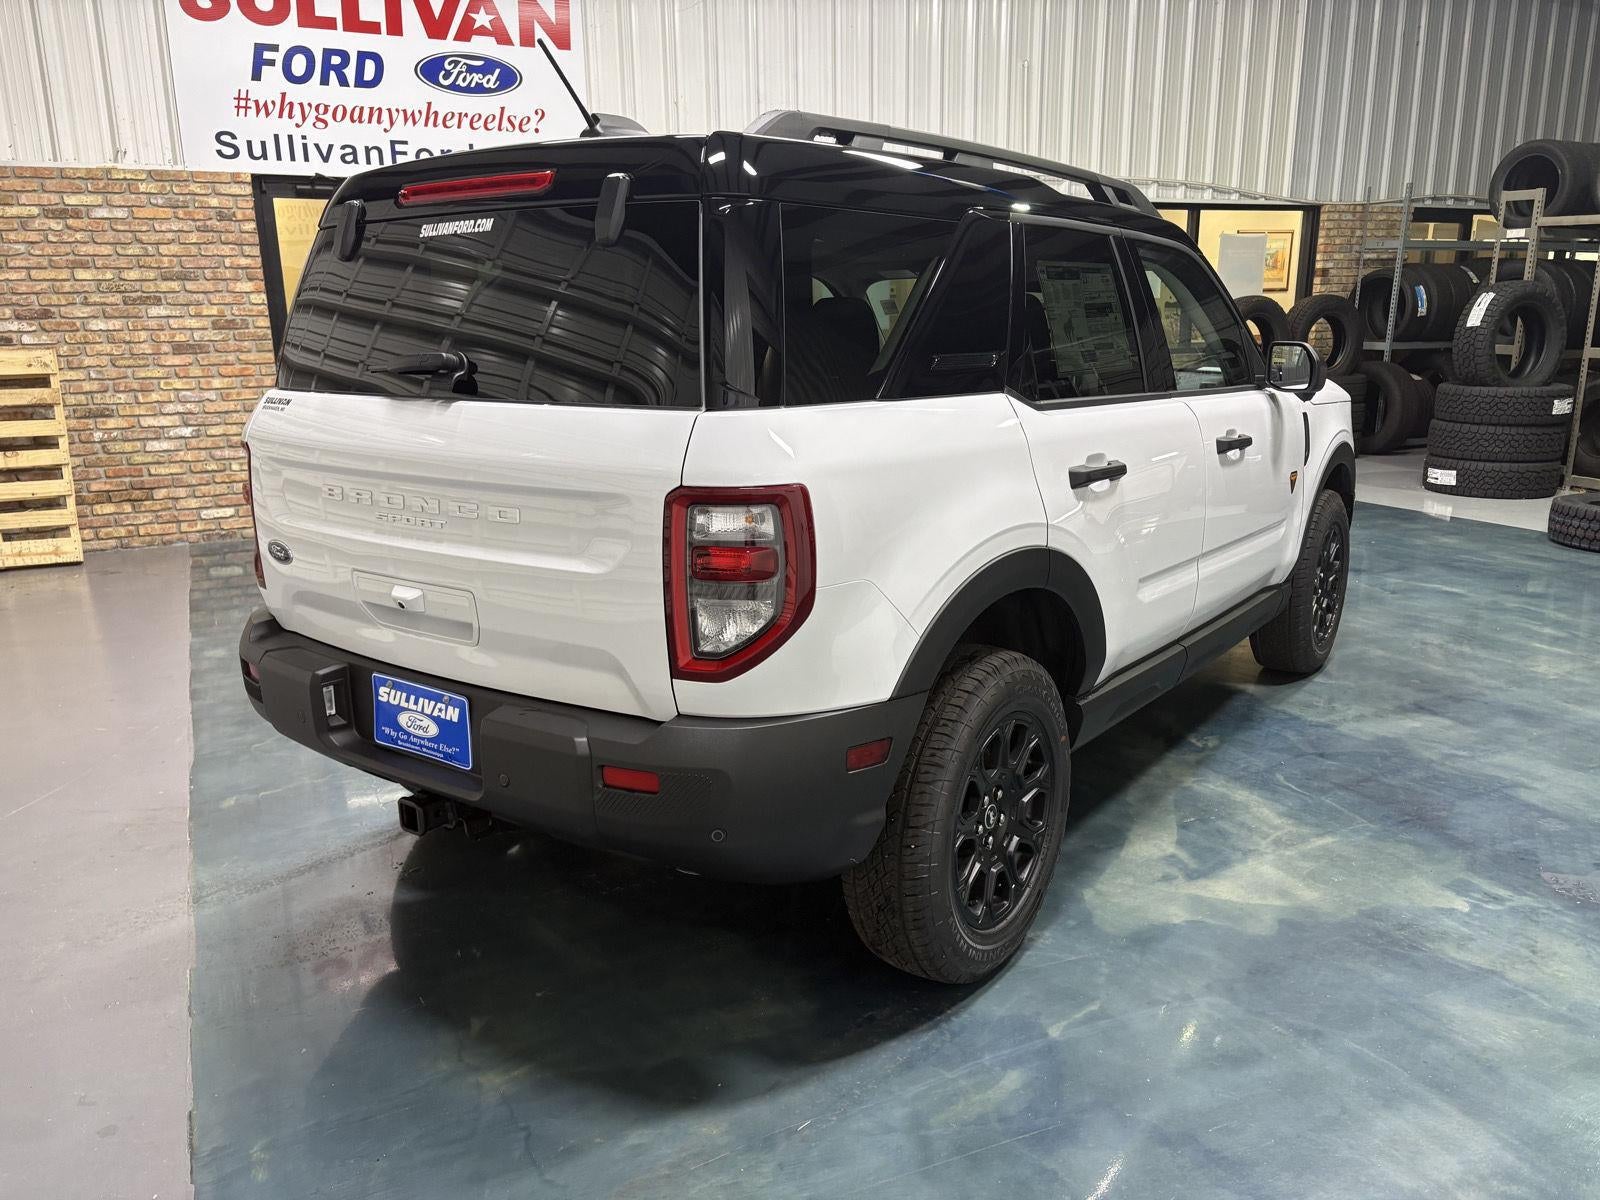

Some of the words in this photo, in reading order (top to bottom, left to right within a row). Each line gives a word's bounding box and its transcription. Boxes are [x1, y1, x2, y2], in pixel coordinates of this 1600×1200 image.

[251, 43, 384, 89] FORD
[438, 56, 500, 90] Ford
[233, 89, 545, 134] #whygoanywhereelse?
[420, 218, 494, 237] SULLIVANFORD.COM
[321, 484, 521, 524] BRONCO
[375, 511, 447, 529] SPORT
[378, 686, 460, 723] SULLIVAN
[398, 731, 408, 740] Go
[408, 735, 438, 751] Anywhere
[405, 715, 430, 734] Ford
